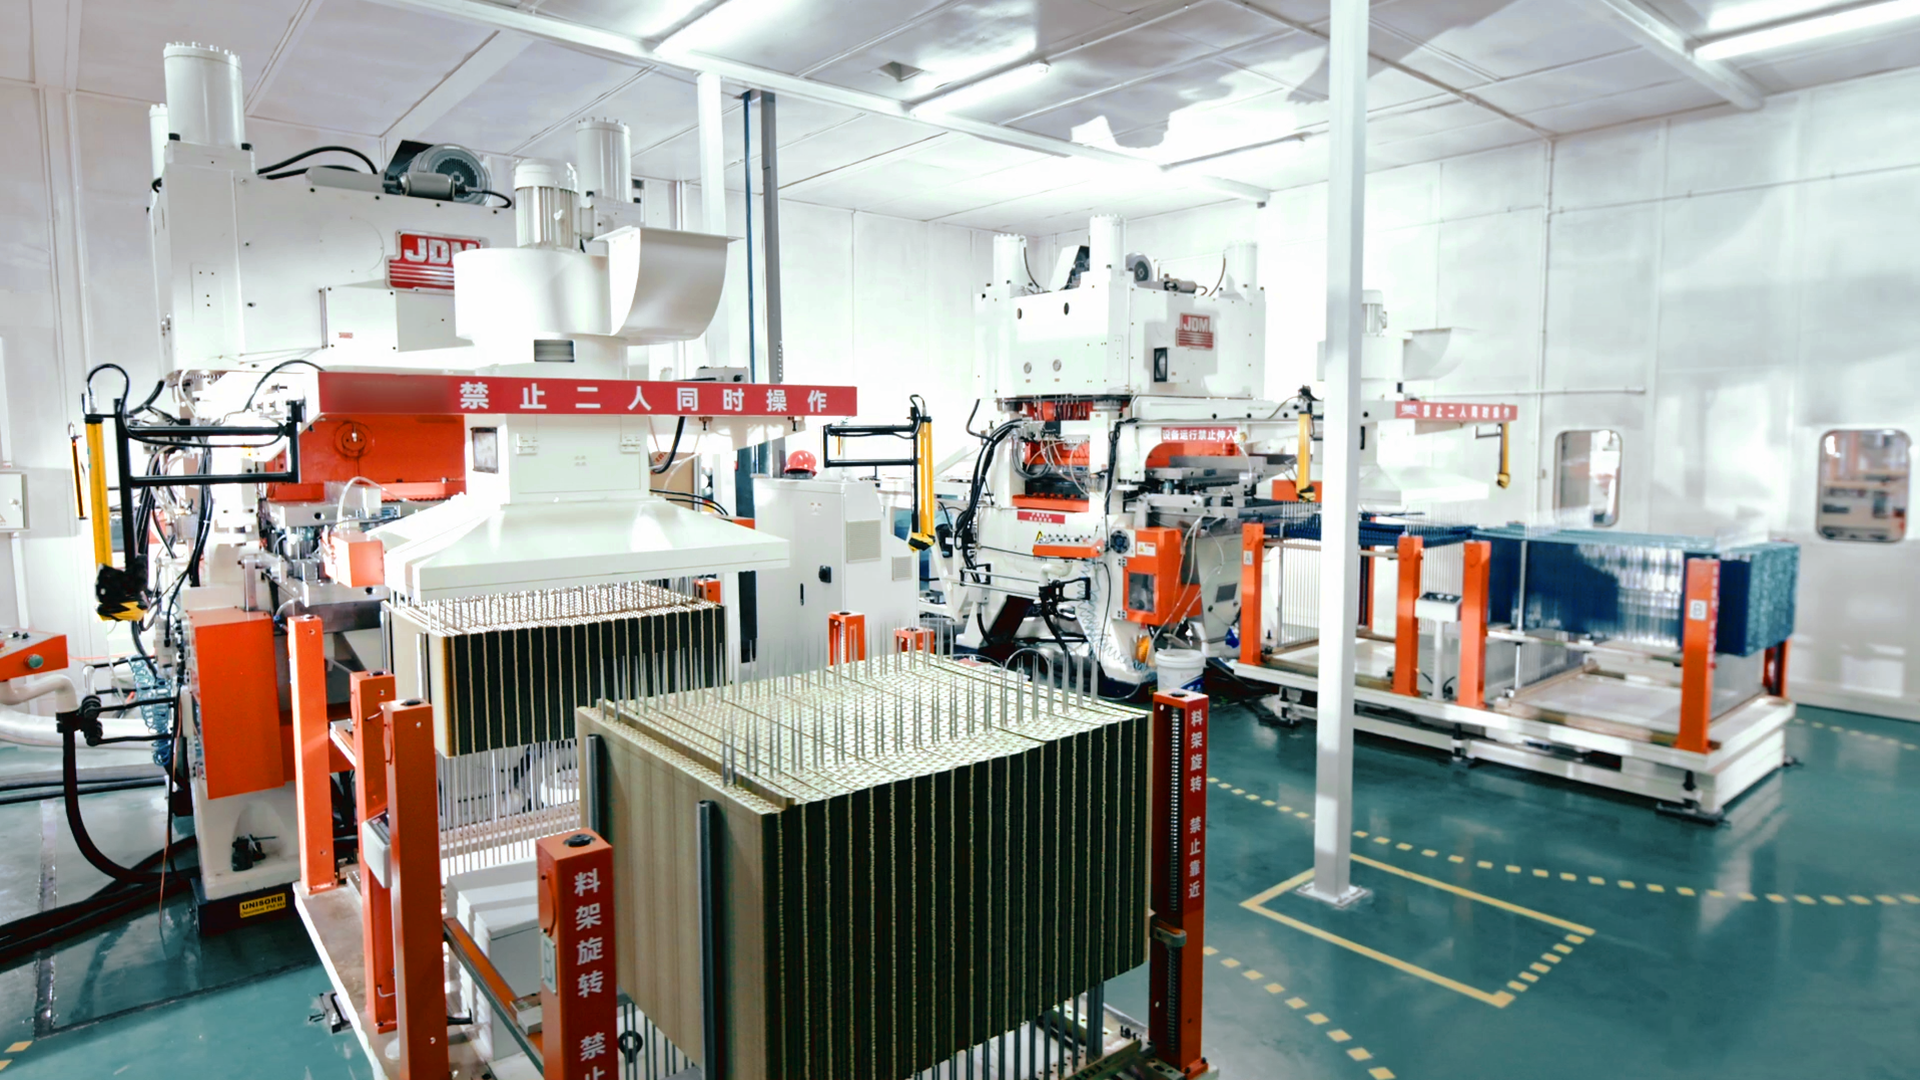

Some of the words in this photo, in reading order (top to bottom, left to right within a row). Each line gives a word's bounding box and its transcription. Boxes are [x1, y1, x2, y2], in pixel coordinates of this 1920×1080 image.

[1183, 316, 1209, 333] JDM
[460, 381, 827, 412] 禁止二人同时操作
[1190, 709, 1203, 792] 料架旋转
[1189, 816, 1202, 899] 禁止靠近
[242, 895, 283, 910] UNISORB
[574, 868, 604, 998] 料架旋转
